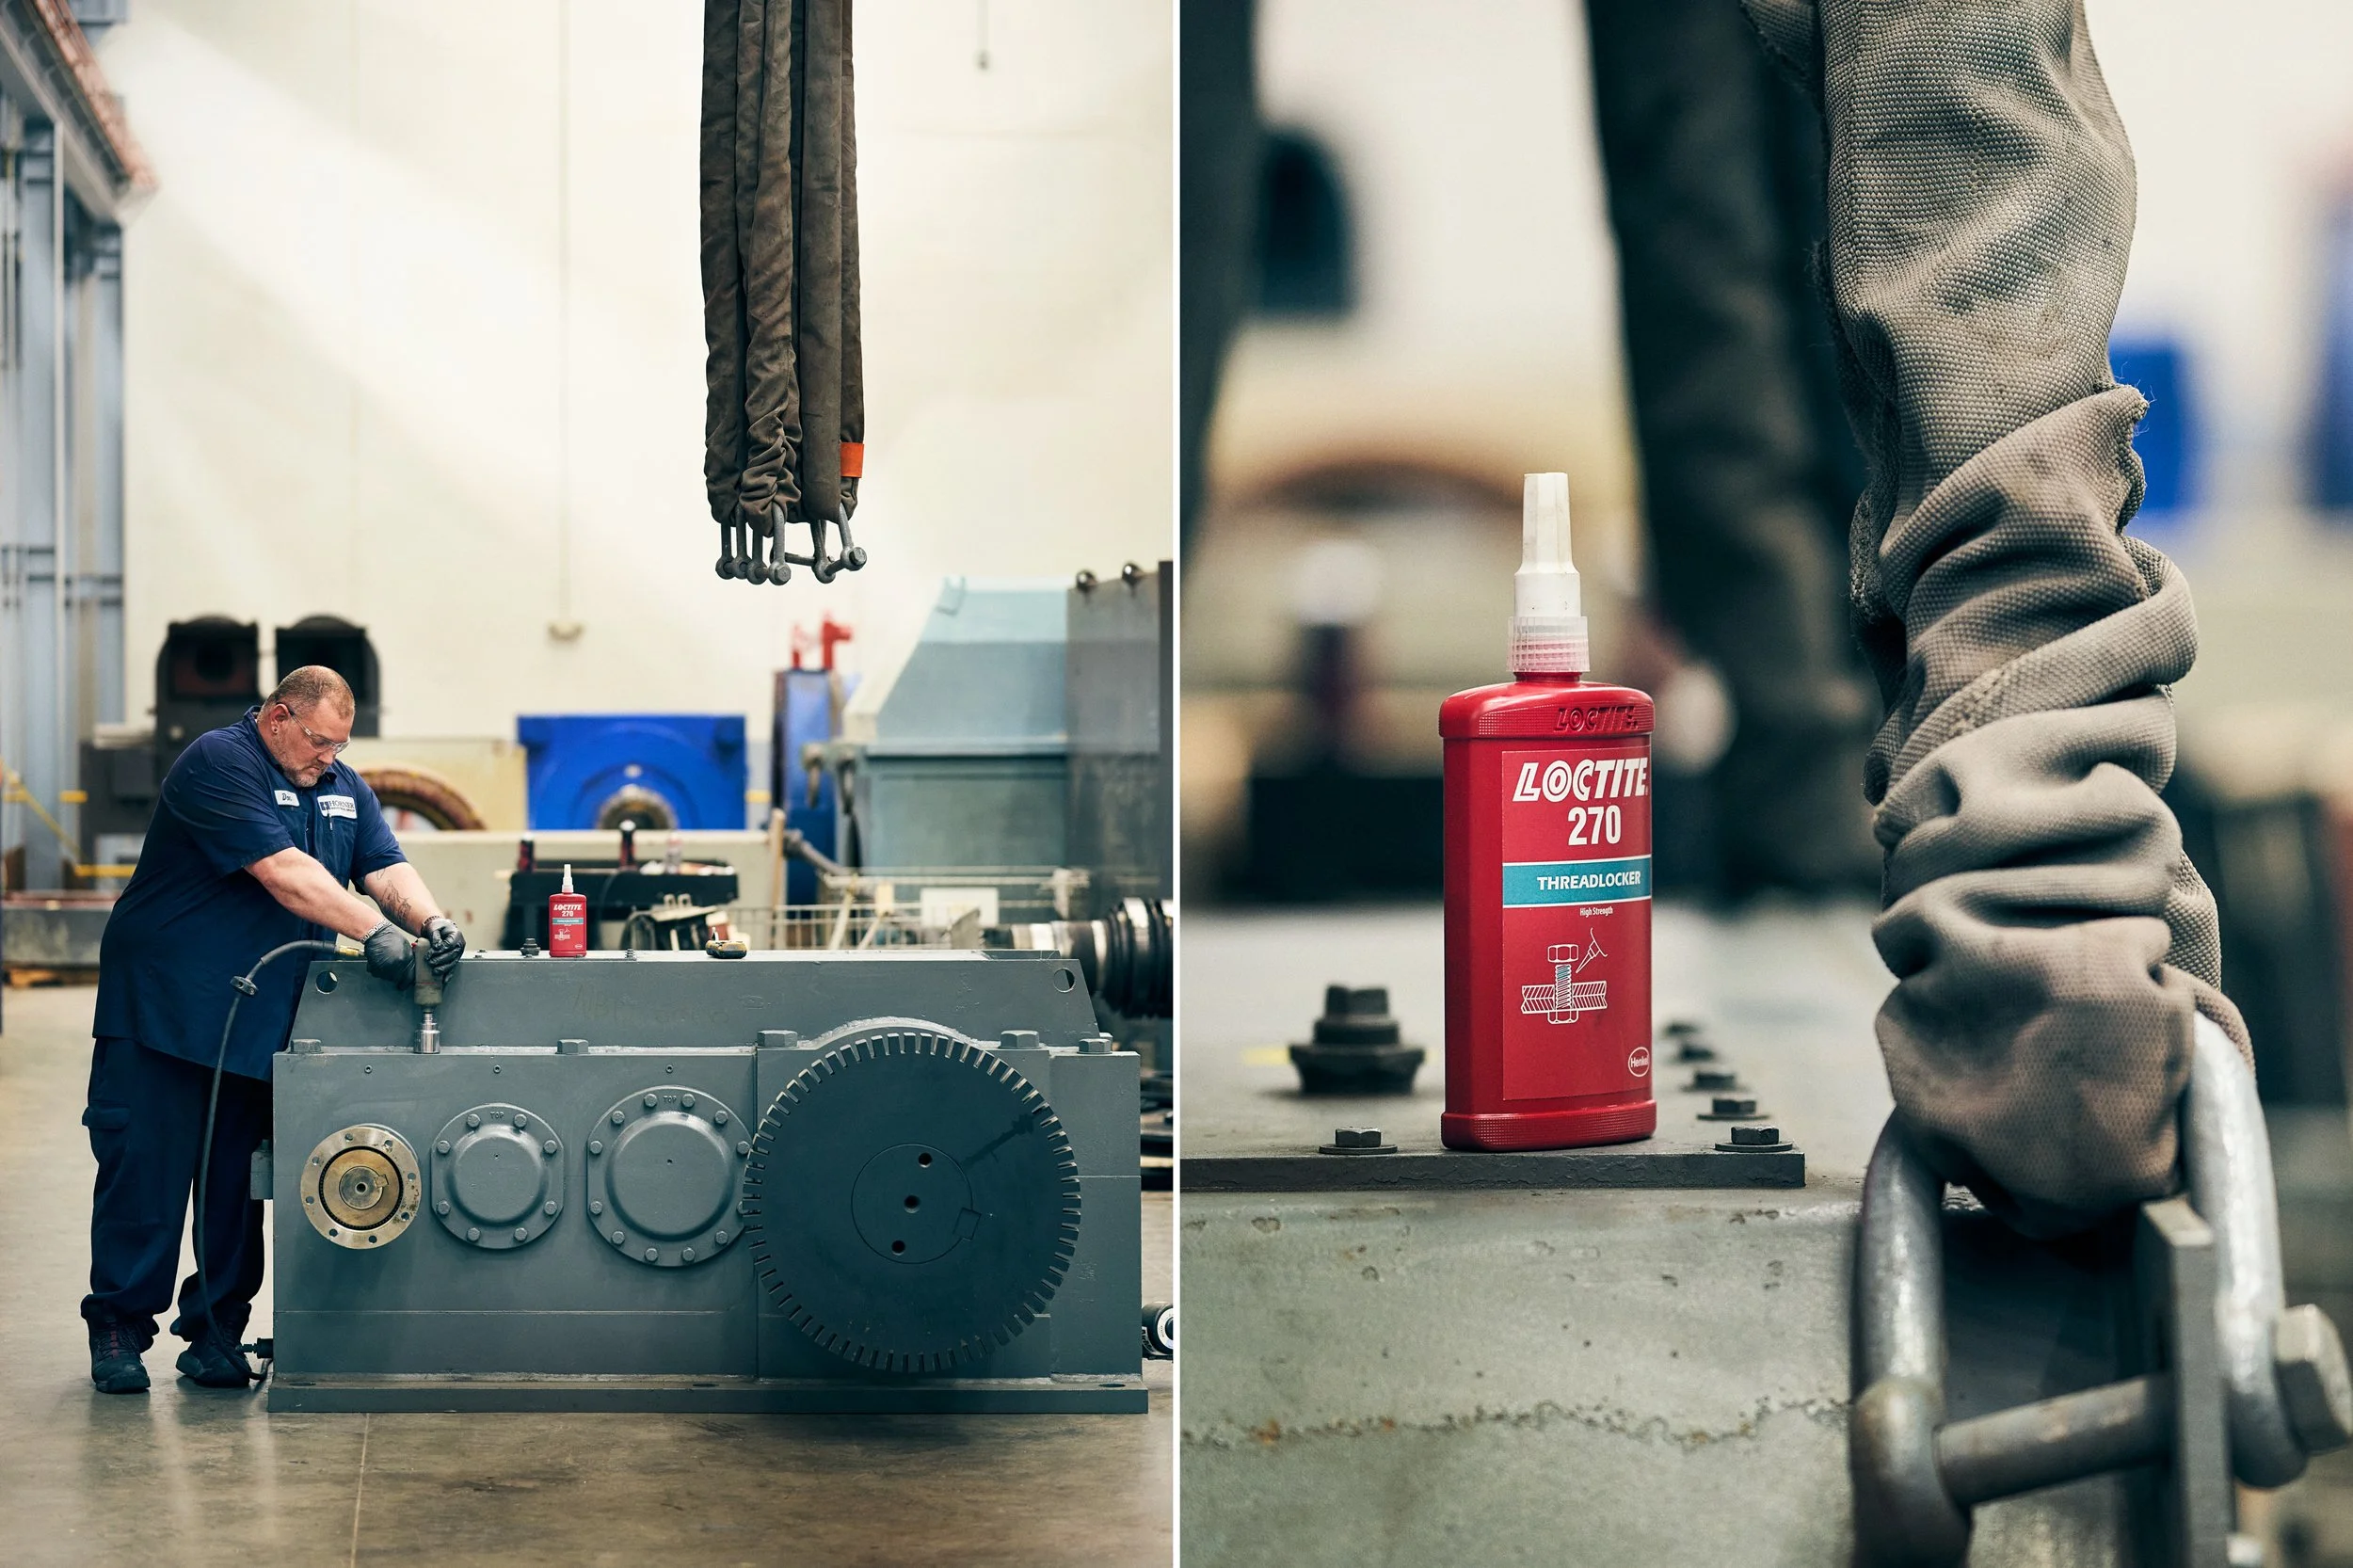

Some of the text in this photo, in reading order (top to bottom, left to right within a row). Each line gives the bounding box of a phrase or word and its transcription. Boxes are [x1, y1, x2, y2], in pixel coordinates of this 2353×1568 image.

[1554, 706, 1638, 732] LOCTITE
[1513, 758, 1648, 802] LOCTITE
[1568, 805, 1621, 846] 270
[1537, 871, 1641, 890] THREADLOCKER
[1580, 906, 1613, 918] High Strength
[489, 1111, 504, 1119] TOP
